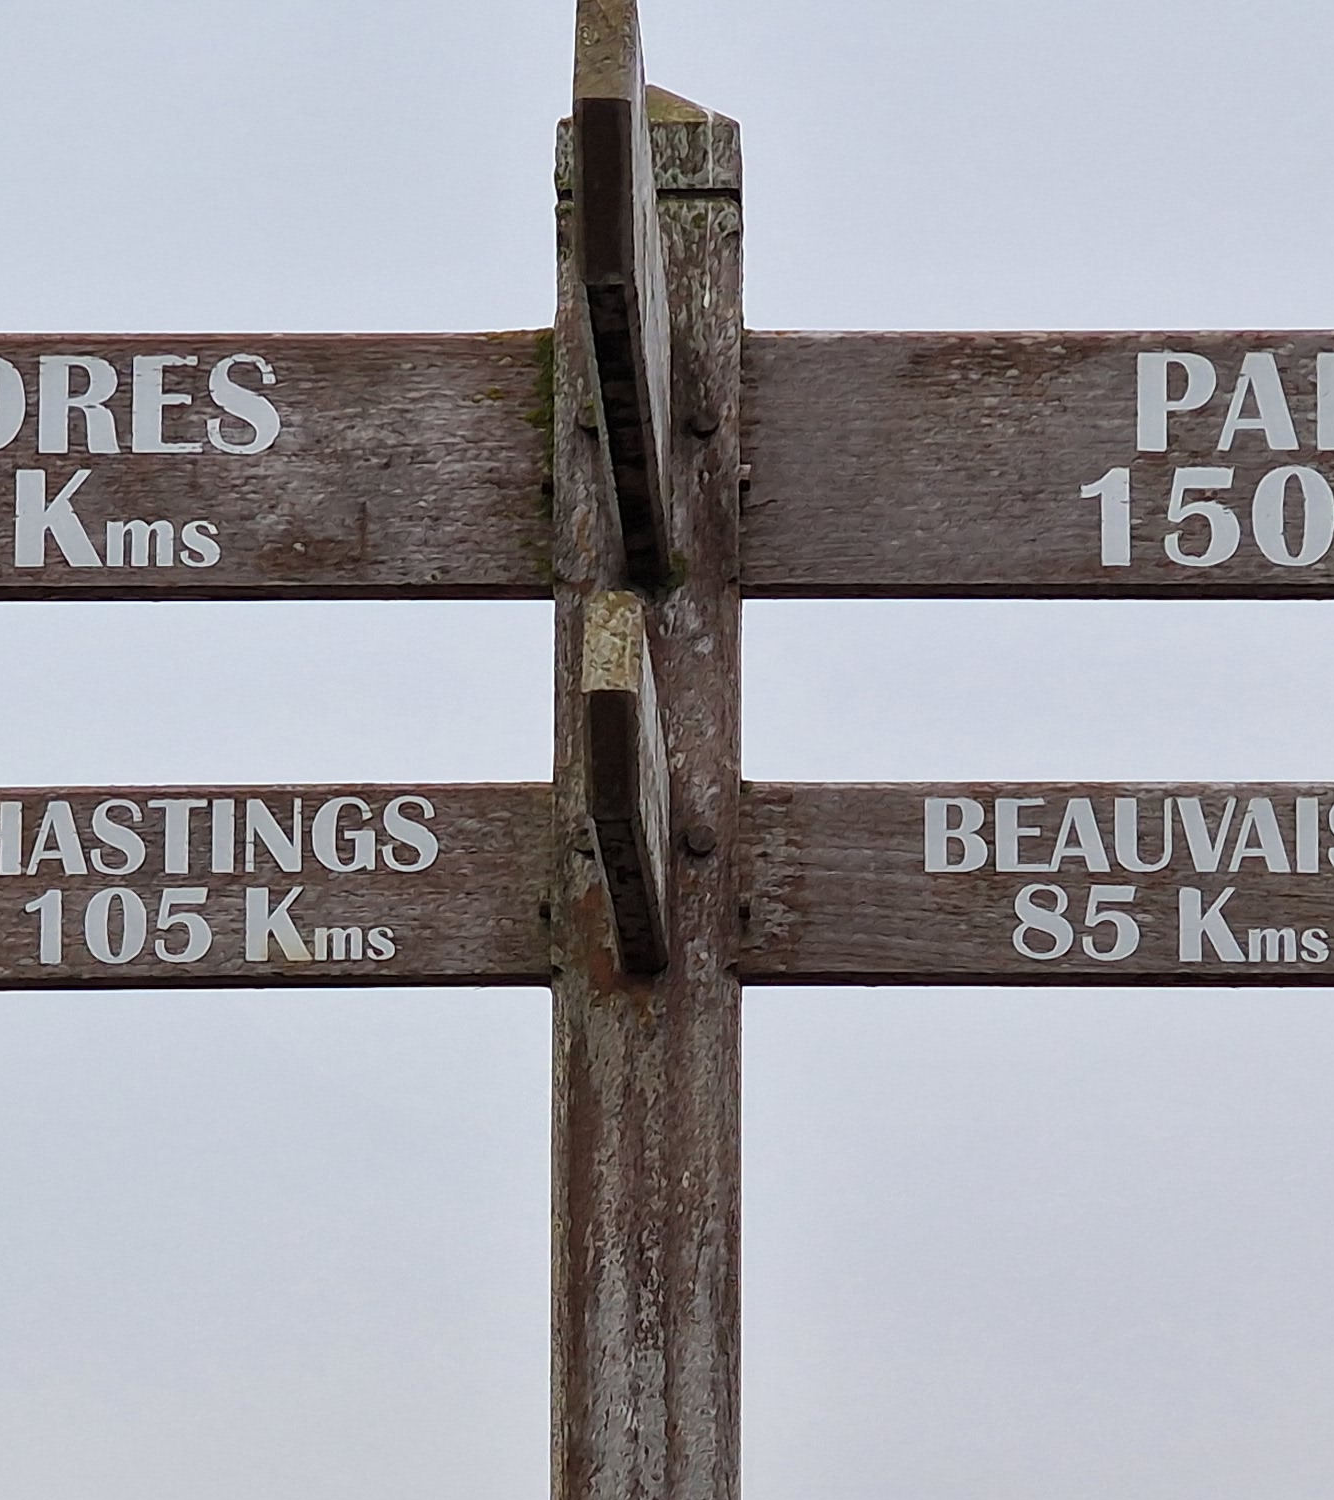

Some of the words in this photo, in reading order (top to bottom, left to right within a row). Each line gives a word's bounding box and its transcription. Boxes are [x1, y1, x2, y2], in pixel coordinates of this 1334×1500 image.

[14, 468, 221, 568] Kms
[25, 886, 213, 964] 105
[245, 885, 396, 962] Kms
[1012, 883, 1140, 961] 85
[1178, 885, 1330, 963] Kms
